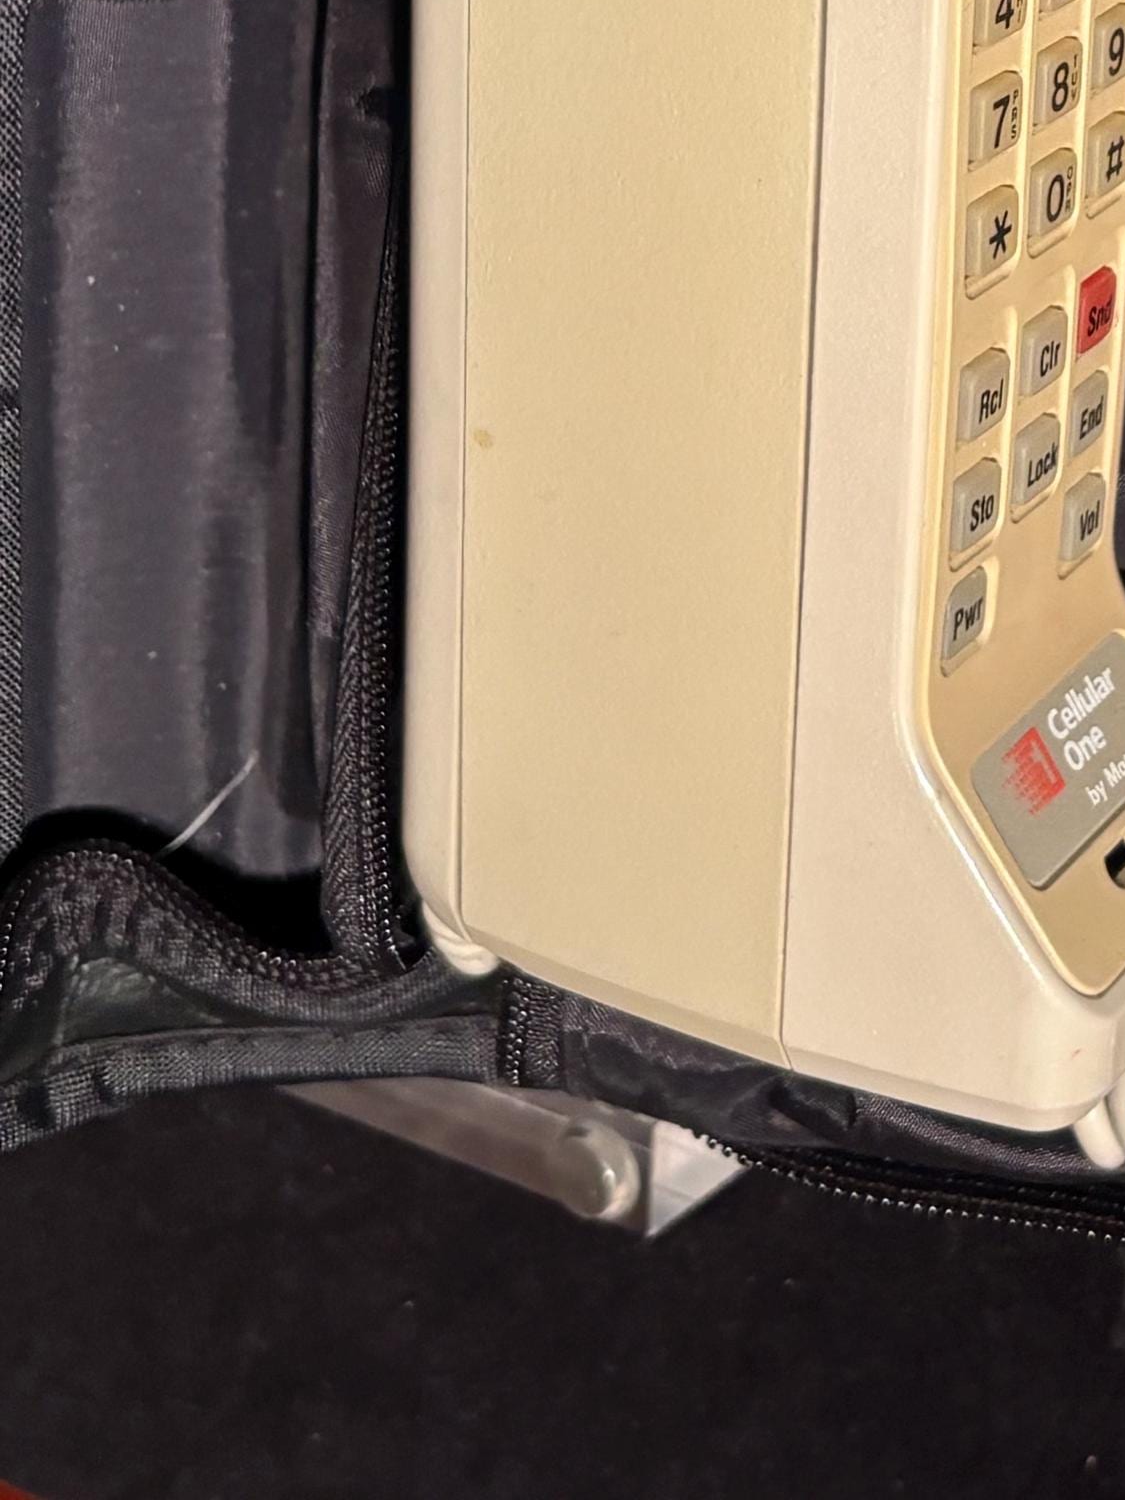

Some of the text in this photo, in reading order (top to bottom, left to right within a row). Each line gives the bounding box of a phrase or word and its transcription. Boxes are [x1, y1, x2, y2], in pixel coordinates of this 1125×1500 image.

[1109, 27, 1125, 76] 9
[1051, 61, 1069, 112] 8
[993, 94, 1011, 149] 7
[1046, 174, 1065, 223] 0
[1087, 294, 1113, 337] Snd
[1040, 341, 1061, 377] Clr
[978, 378, 1004, 424] Rcl
[1079, 395, 1104, 440] End
[1027, 442, 1059, 488] Lock
[970, 494, 995, 532] Sto
[1079, 500, 1100, 541] Vol
[952, 597, 983, 641] Pwr
[1047, 667, 1116, 740] Cellular
[1063, 725, 1107, 772] One
[1087, 781, 1108, 808] by
